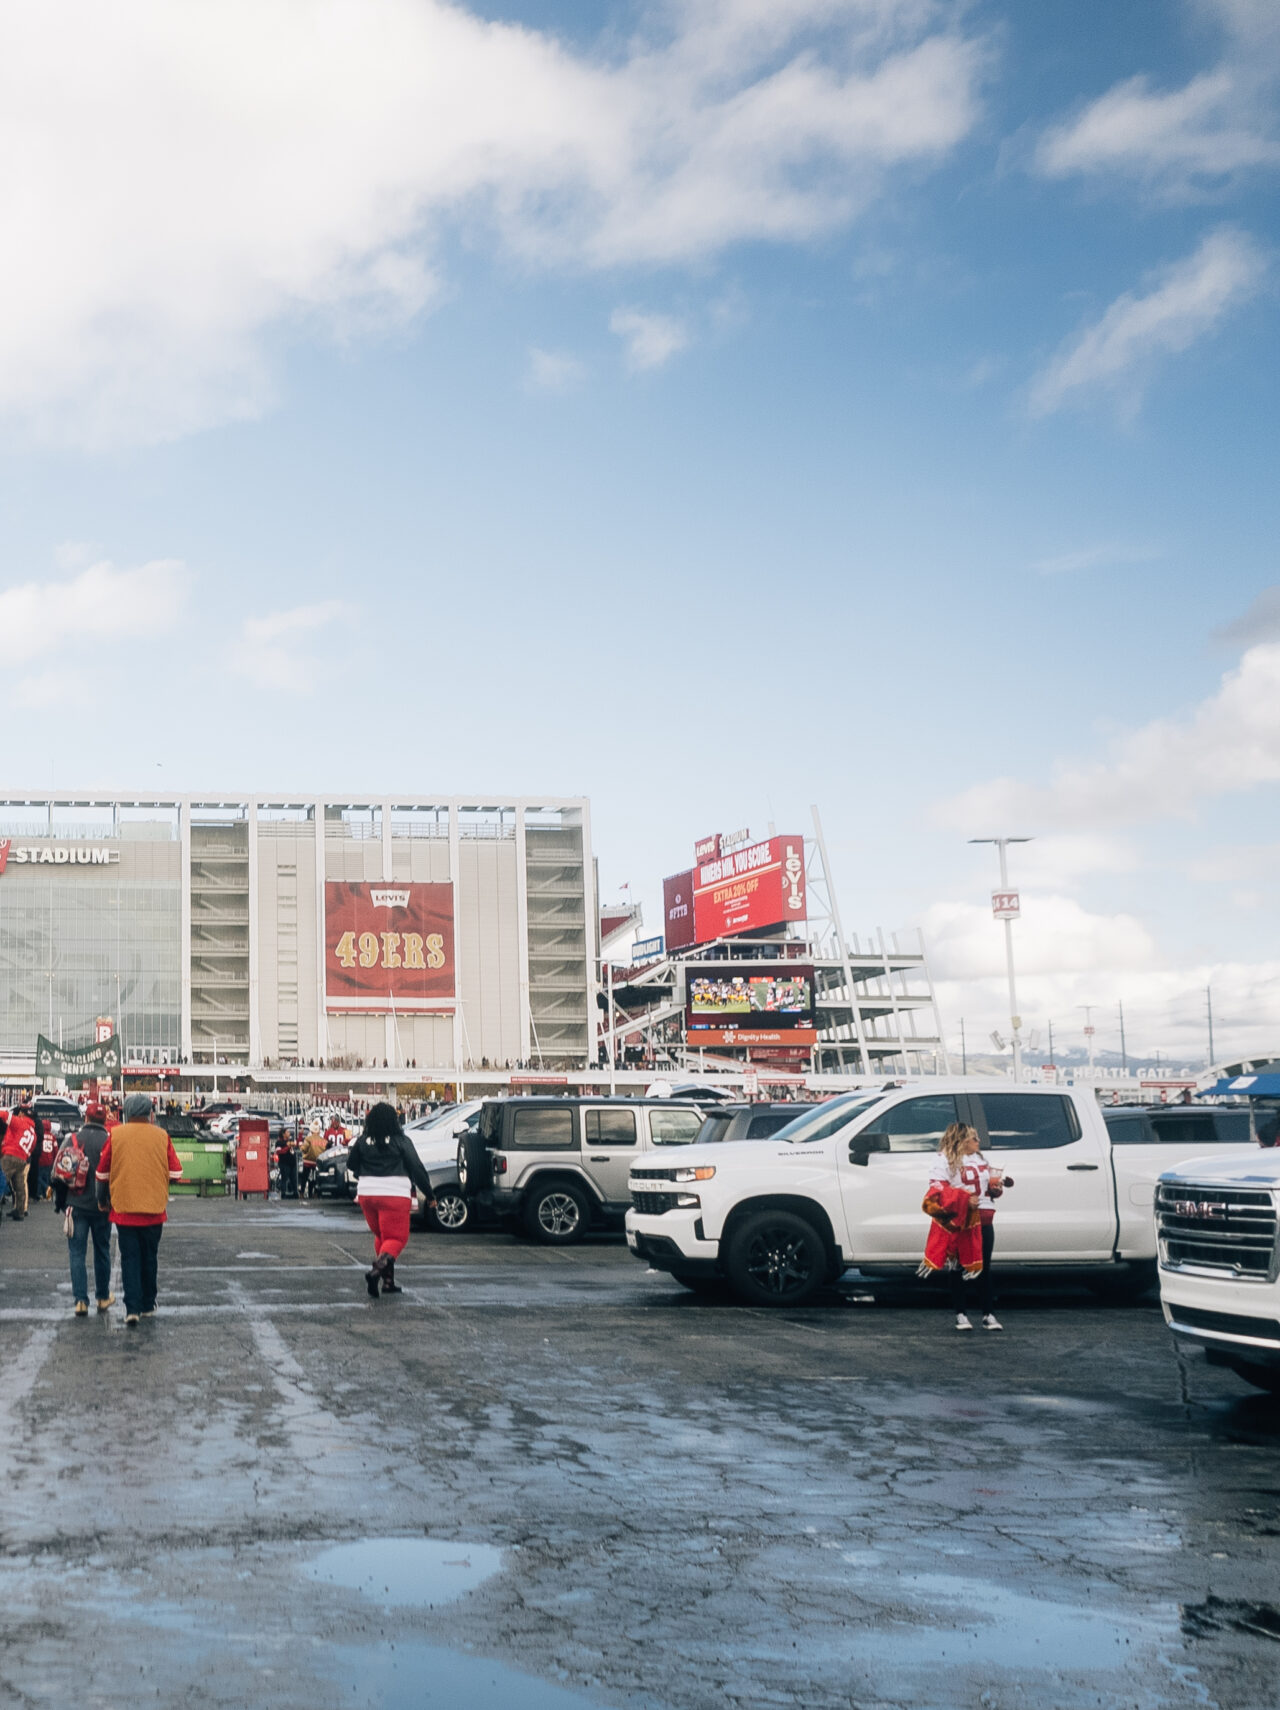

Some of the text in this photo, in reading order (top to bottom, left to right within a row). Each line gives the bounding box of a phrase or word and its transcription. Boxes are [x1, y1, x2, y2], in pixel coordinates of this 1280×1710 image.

[16, 847, 110, 864] STADIUM
[713, 888, 733, 904] EXTRA
[746, 877, 759, 893] OFF
[335, 931, 446, 969] 49ERS
[737, 1032, 781, 1042] Dignity Health
[60, 1061, 96, 1075] CENTER
[1073, 1067, 1130, 1079] HEALTH
[1136, 1067, 1172, 1079] GATE
[1175, 1200, 1226, 1219] GMC
